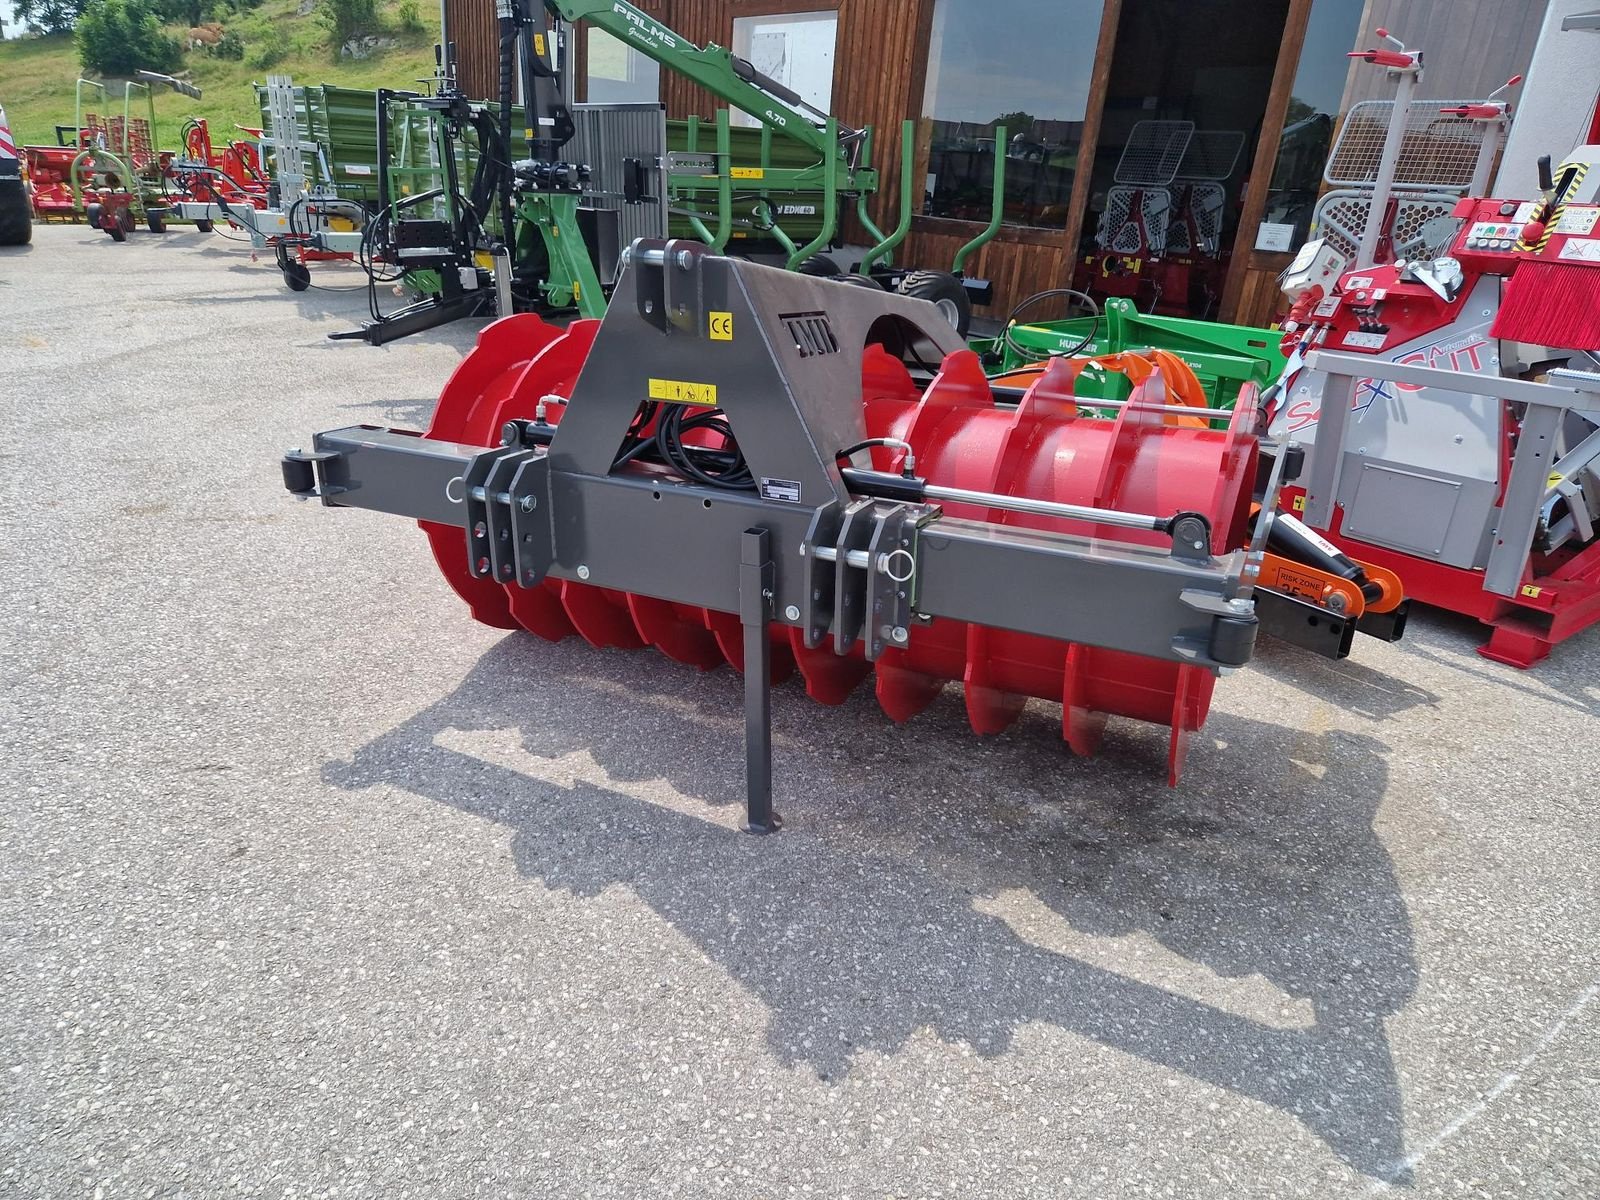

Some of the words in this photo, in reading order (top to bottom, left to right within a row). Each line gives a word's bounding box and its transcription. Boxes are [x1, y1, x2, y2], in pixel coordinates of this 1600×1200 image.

[613, 2, 676, 48] PALMS
[1281, 572, 1298, 584] RISK
[1300, 579, 1321, 591] ZONE
